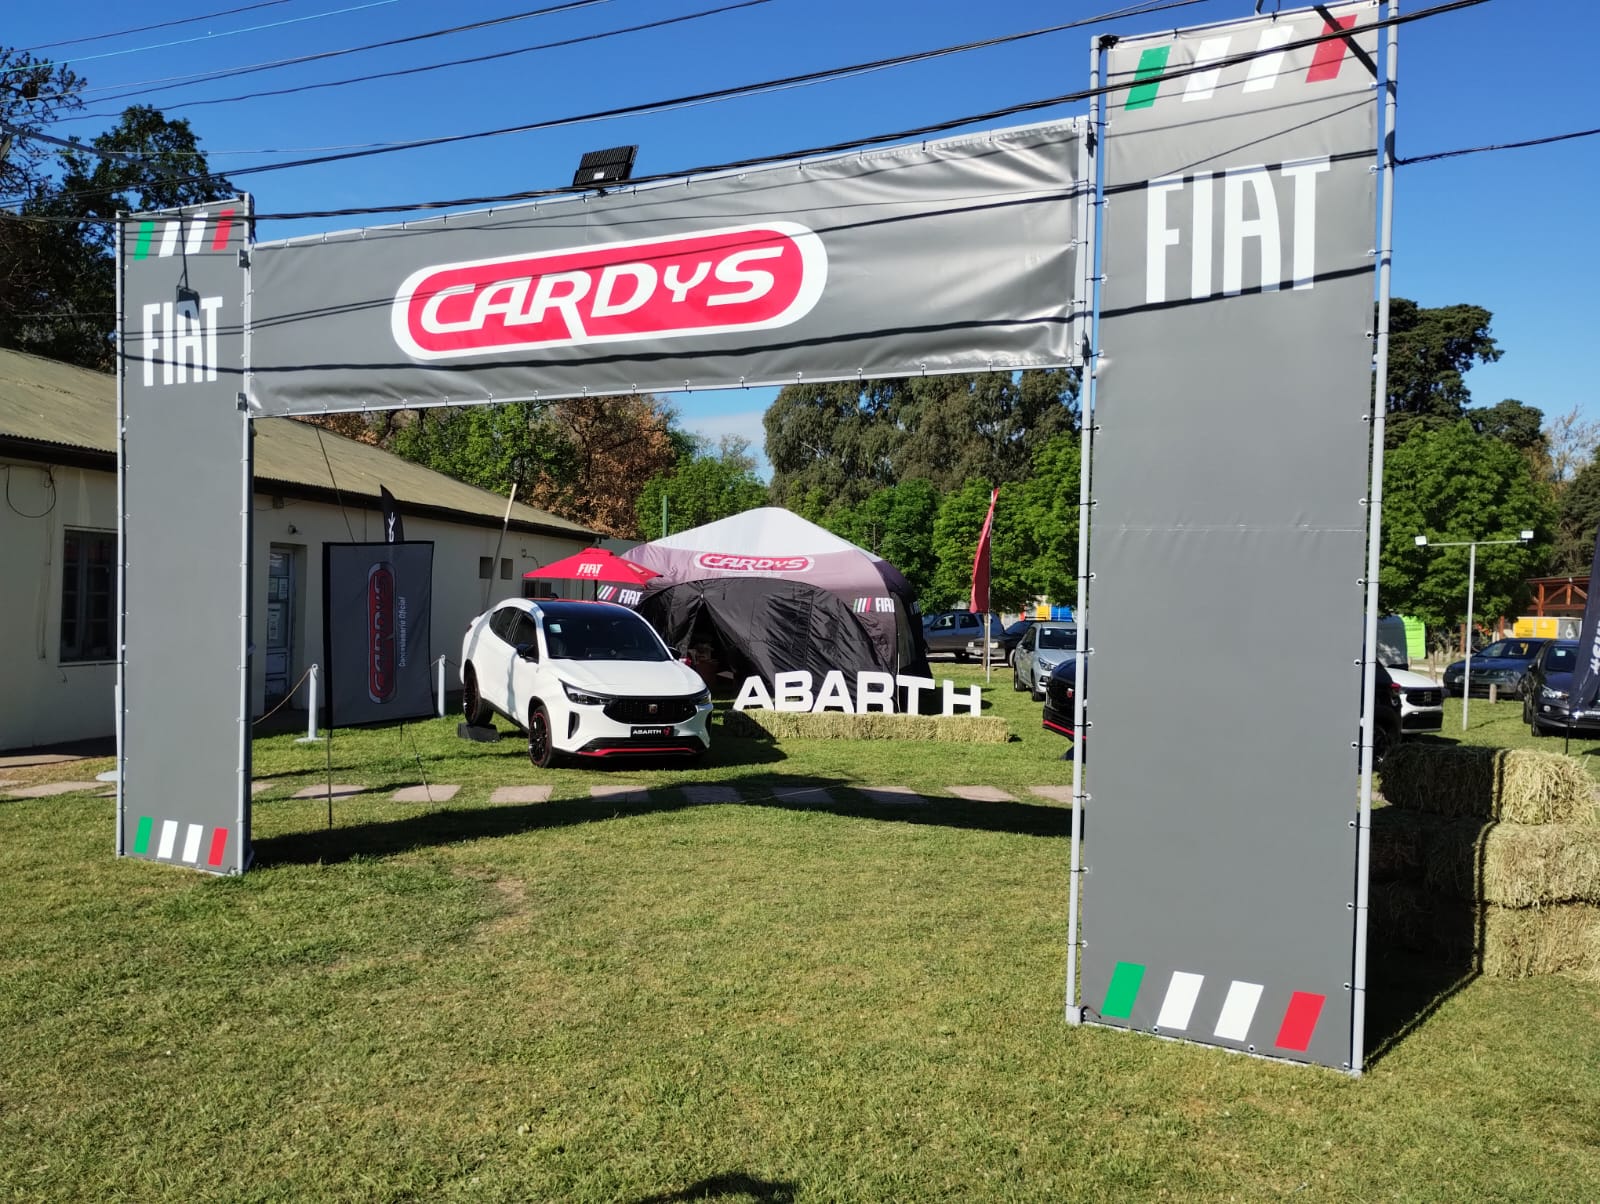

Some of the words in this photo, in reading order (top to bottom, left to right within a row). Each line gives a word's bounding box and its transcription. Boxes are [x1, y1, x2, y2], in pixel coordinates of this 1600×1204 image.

[1146, 155, 1331, 304] FIAT
[420, 246, 785, 339] CARDYS
[143, 296, 223, 387] FIAT
[577, 563, 603, 574] FIAT
[703, 556, 805, 571] CARDYS
[618, 589, 644, 605] FIAT
[732, 670, 982, 717] ABARTH
